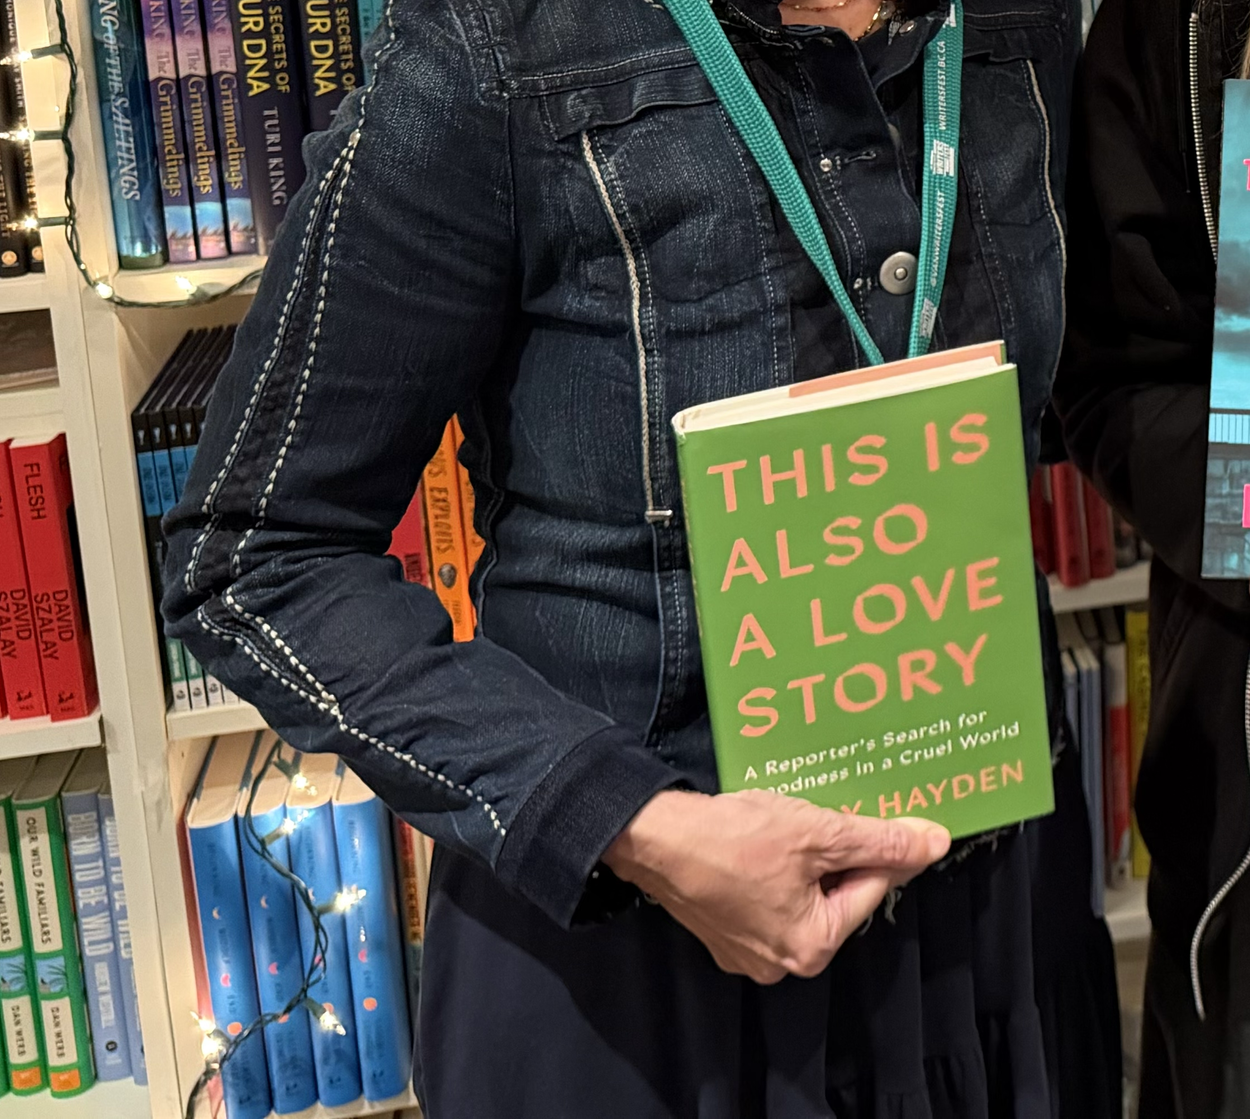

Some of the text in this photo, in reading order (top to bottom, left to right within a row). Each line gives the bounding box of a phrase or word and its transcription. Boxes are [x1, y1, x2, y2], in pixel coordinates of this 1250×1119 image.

[242, 39, 271, 97] DNA
[269, 5, 287, 69] SECRETS
[275, 73, 290, 94] OF
[188, 76, 216, 194] Grimmelings
[262, 106, 288, 206] TURI KING
[23, 462, 46, 521] FLESH
[706, 412, 990, 514] THIS IS
[719, 503, 928, 592] ALSO
[34, 592, 59, 661] SZALAY
[53, 590, 74, 643] DAVID
[729, 556, 1003, 668] A LOVE
[736, 633, 988, 738] STORY
[744, 710, 987, 782] A Reporter's Search for
[856, 761, 874, 776] in
[882, 758, 892, 771] a
[899, 741, 952, 765] Cruel
[959, 721, 1020, 750] World
[878, 760, 1024, 818] HAYDEN
[25, 817, 52, 945] OUR WILD FAMILIARS
